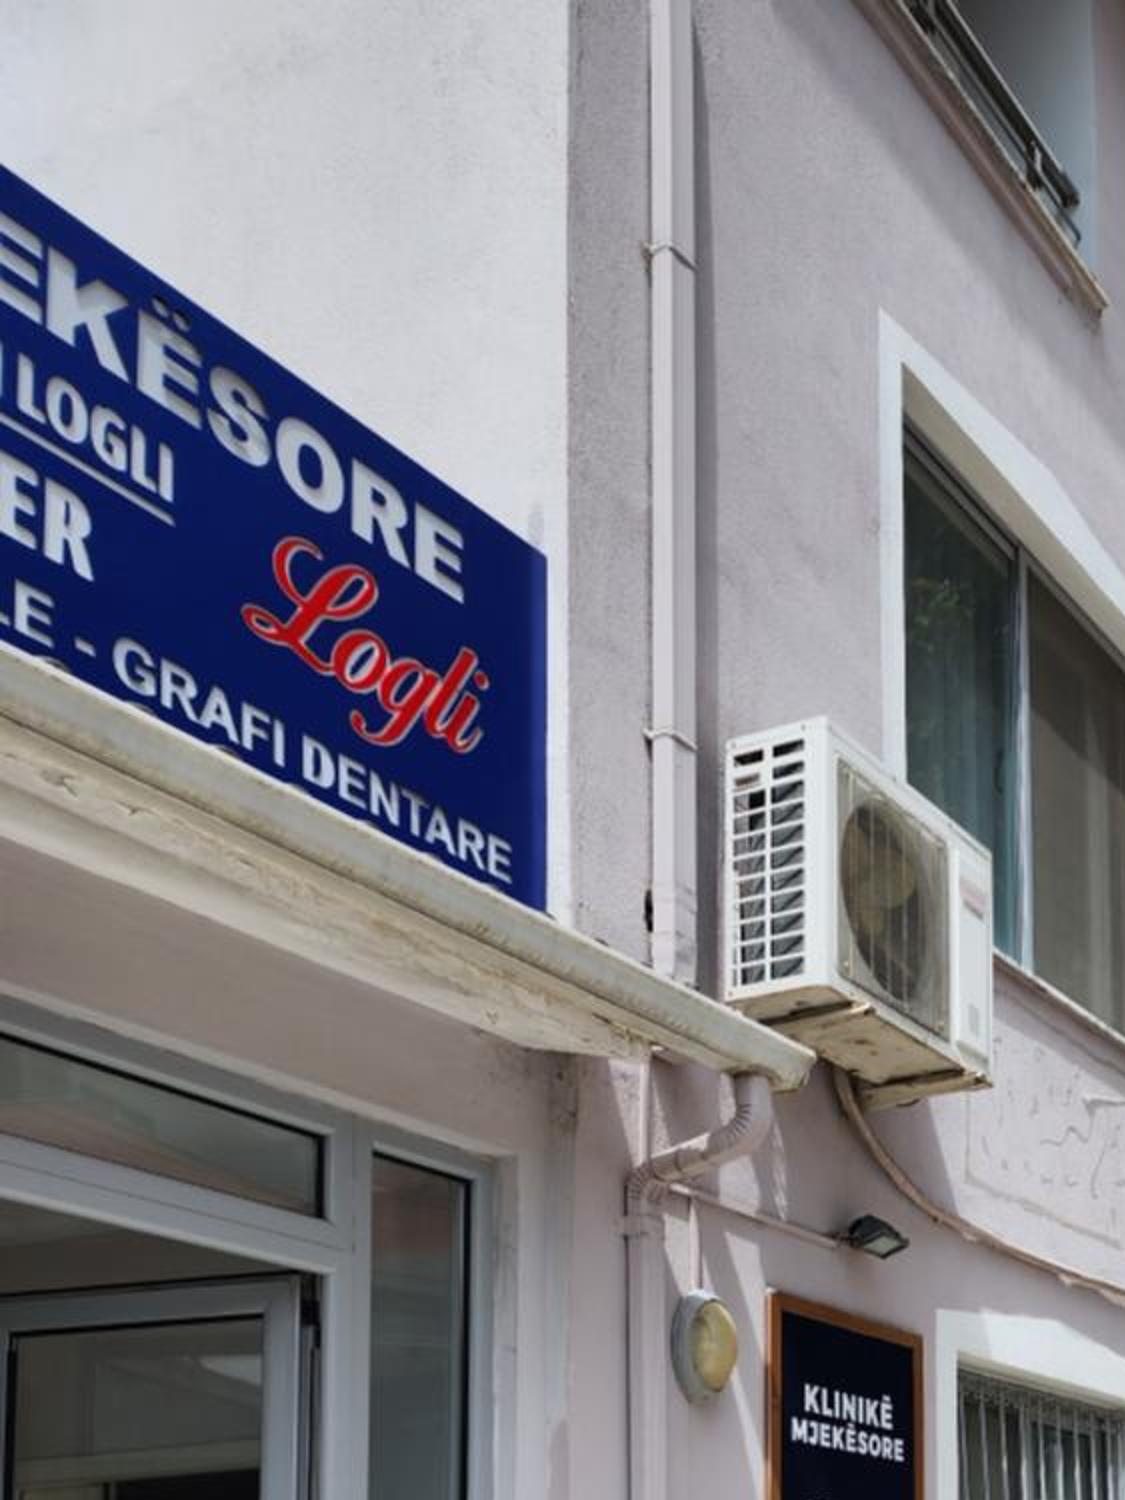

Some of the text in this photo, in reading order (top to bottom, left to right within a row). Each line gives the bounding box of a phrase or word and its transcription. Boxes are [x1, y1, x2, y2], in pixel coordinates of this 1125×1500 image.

[17, 352, 175, 503] LOGLI
[241, 536, 491, 755] Logli
[112, 637, 287, 768] GRAFI
[302, 735, 513, 883] DENTARE
[791, 1416, 904, 1462] MJEKËSORE
[804, 1383, 893, 1430] KLINIKË
